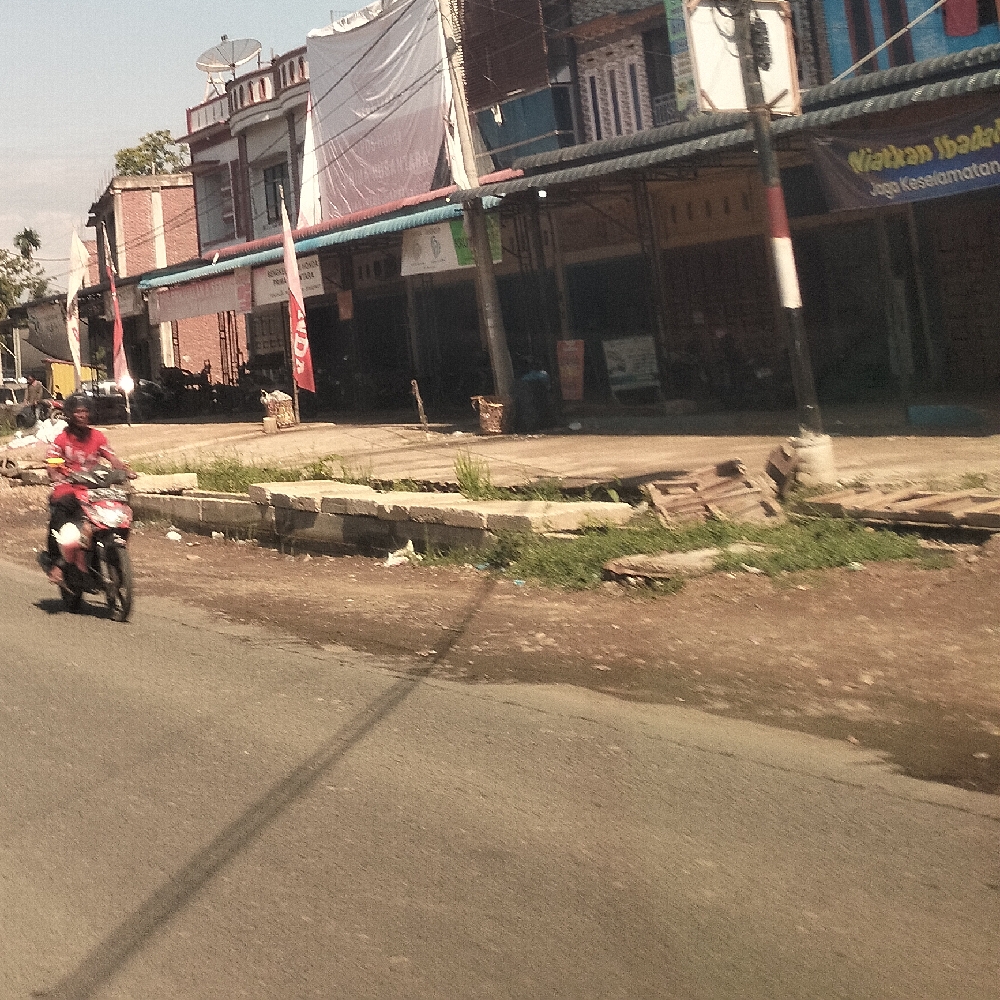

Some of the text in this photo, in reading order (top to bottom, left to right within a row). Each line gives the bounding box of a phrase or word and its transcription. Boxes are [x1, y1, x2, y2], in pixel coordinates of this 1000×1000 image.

[847, 144, 933, 173] Niatkan
[870, 160, 1000, 199] Jaga Keselamatan
